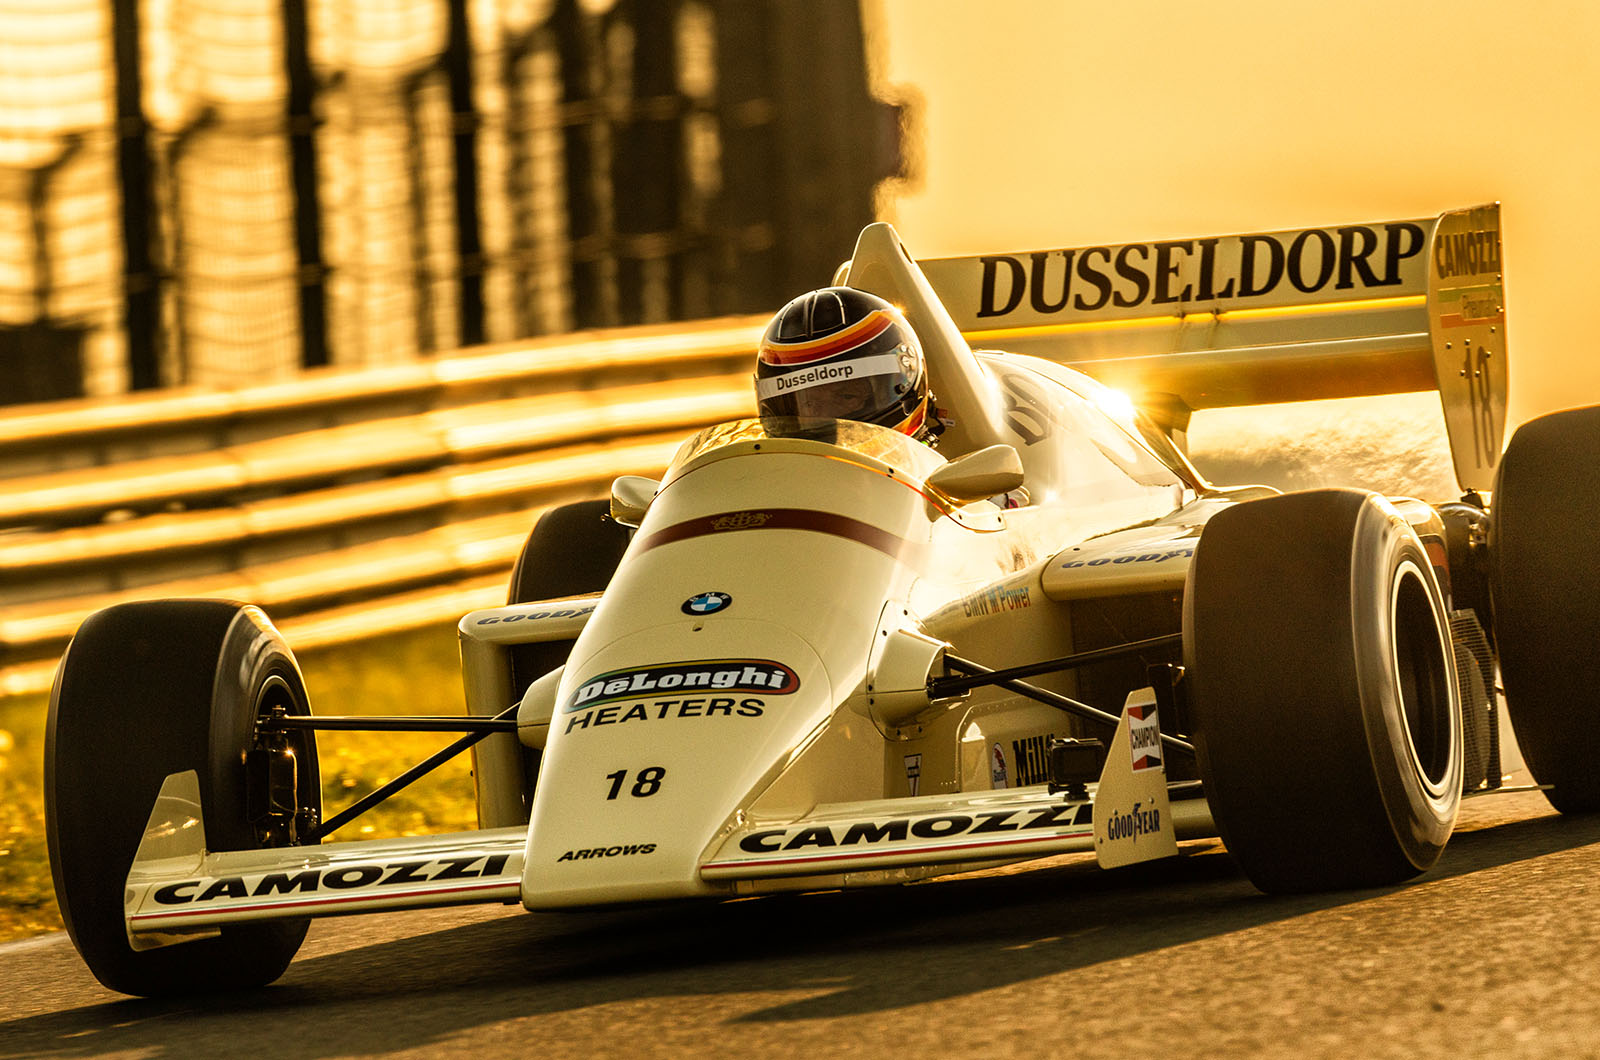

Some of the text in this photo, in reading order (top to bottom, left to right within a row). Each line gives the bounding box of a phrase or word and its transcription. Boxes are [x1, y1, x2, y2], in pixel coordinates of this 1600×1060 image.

[977, 221, 1426, 318] DUSSELDORP
[776, 365, 853, 391] Dusseldorp
[1463, 346, 1496, 469] 18
[565, 700, 766, 735] HEATERS
[1131, 724, 1160, 750] CHAMPION
[606, 766, 666, 801] 18
[739, 804, 1094, 853] CAMOZZI
[557, 843, 657, 863] ARROWS
[154, 855, 510, 905] CAMOZZI
